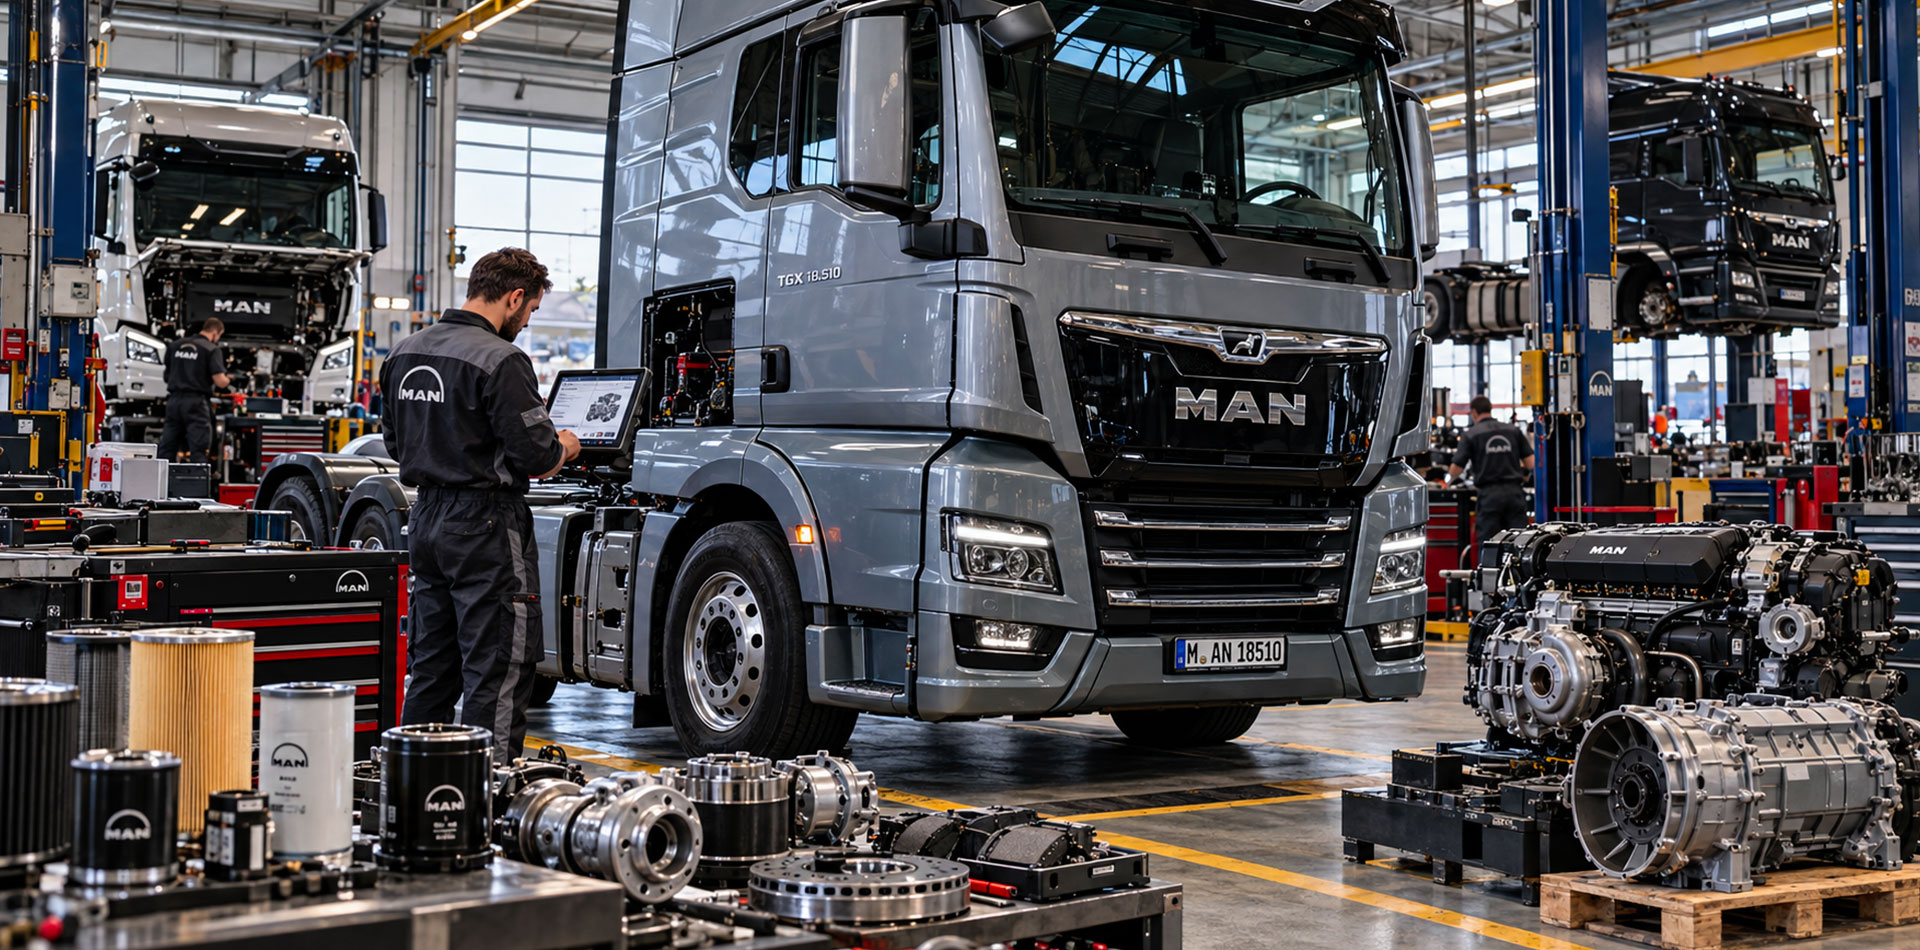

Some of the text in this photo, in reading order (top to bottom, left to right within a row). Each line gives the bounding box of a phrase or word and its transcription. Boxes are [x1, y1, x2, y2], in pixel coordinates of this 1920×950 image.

[1772, 233, 1810, 249] MAN
[777, 266, 841, 287] TGX 18.510
[214, 299, 271, 315] MAN
[174, 350, 199, 360] MAN
[401, 388, 441, 403] MAN
[1589, 384, 1612, 397] MAN
[1175, 387, 1306, 426] MAN
[1589, 545, 1627, 555] MAN
[338, 584, 366, 592] MAN
[1187, 641, 1282, 664] M AN 18510
[273, 758, 305, 768] MAN
[427, 801, 463, 812] MAN
[104, 828, 150, 840] MAN
